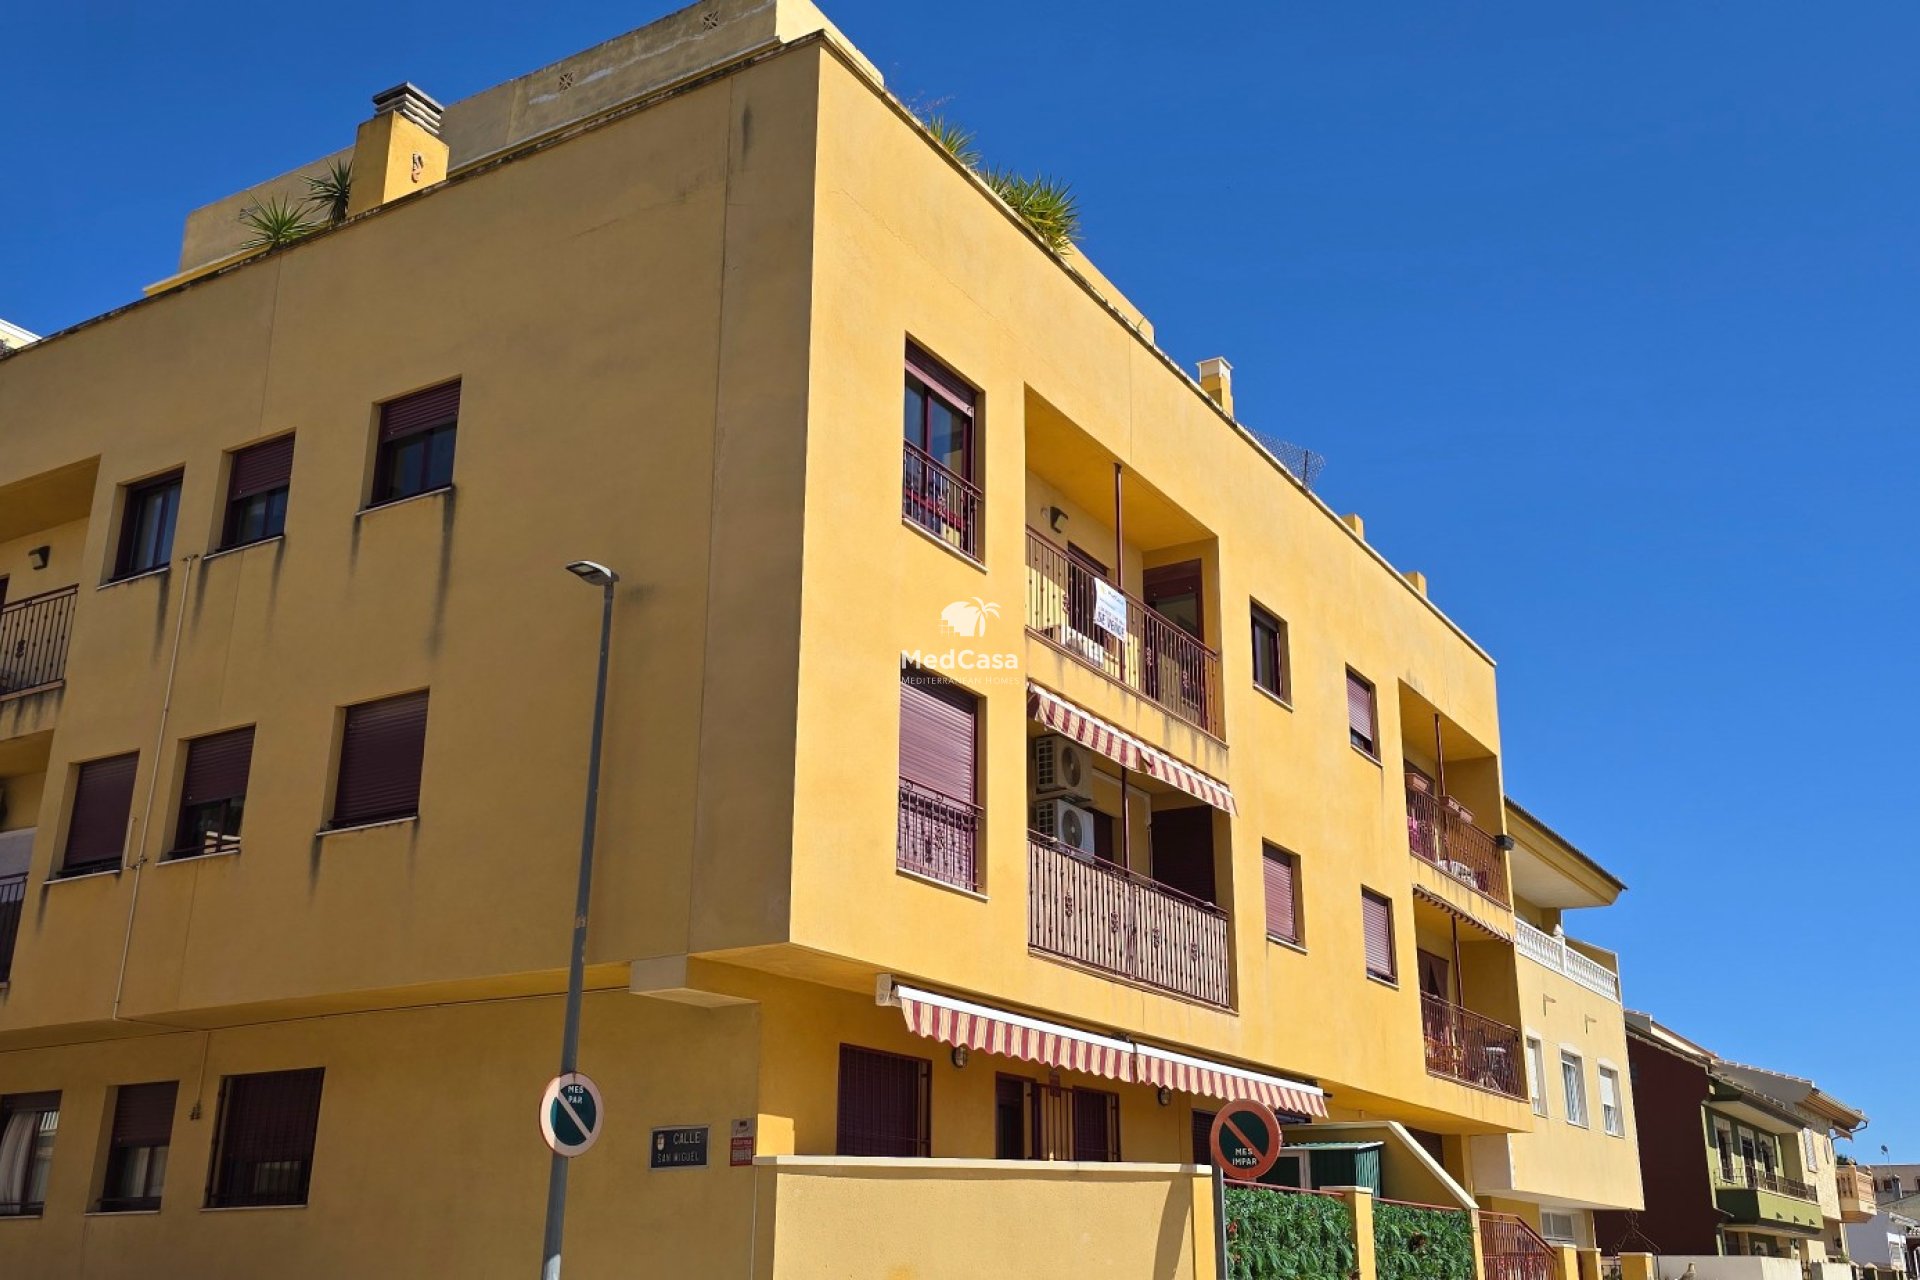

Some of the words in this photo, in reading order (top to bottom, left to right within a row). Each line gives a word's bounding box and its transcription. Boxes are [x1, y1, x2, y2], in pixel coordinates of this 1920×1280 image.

[567, 1085, 584, 1094] MES
[568, 1096, 583, 1104] PAR
[672, 1131, 701, 1145] CALLE
[1235, 1147, 1253, 1156] MES
[657, 1153, 671, 1163] SAN
[673, 1151, 700, 1162] MIGUEL
[1232, 1157, 1258, 1166] IMPAR
